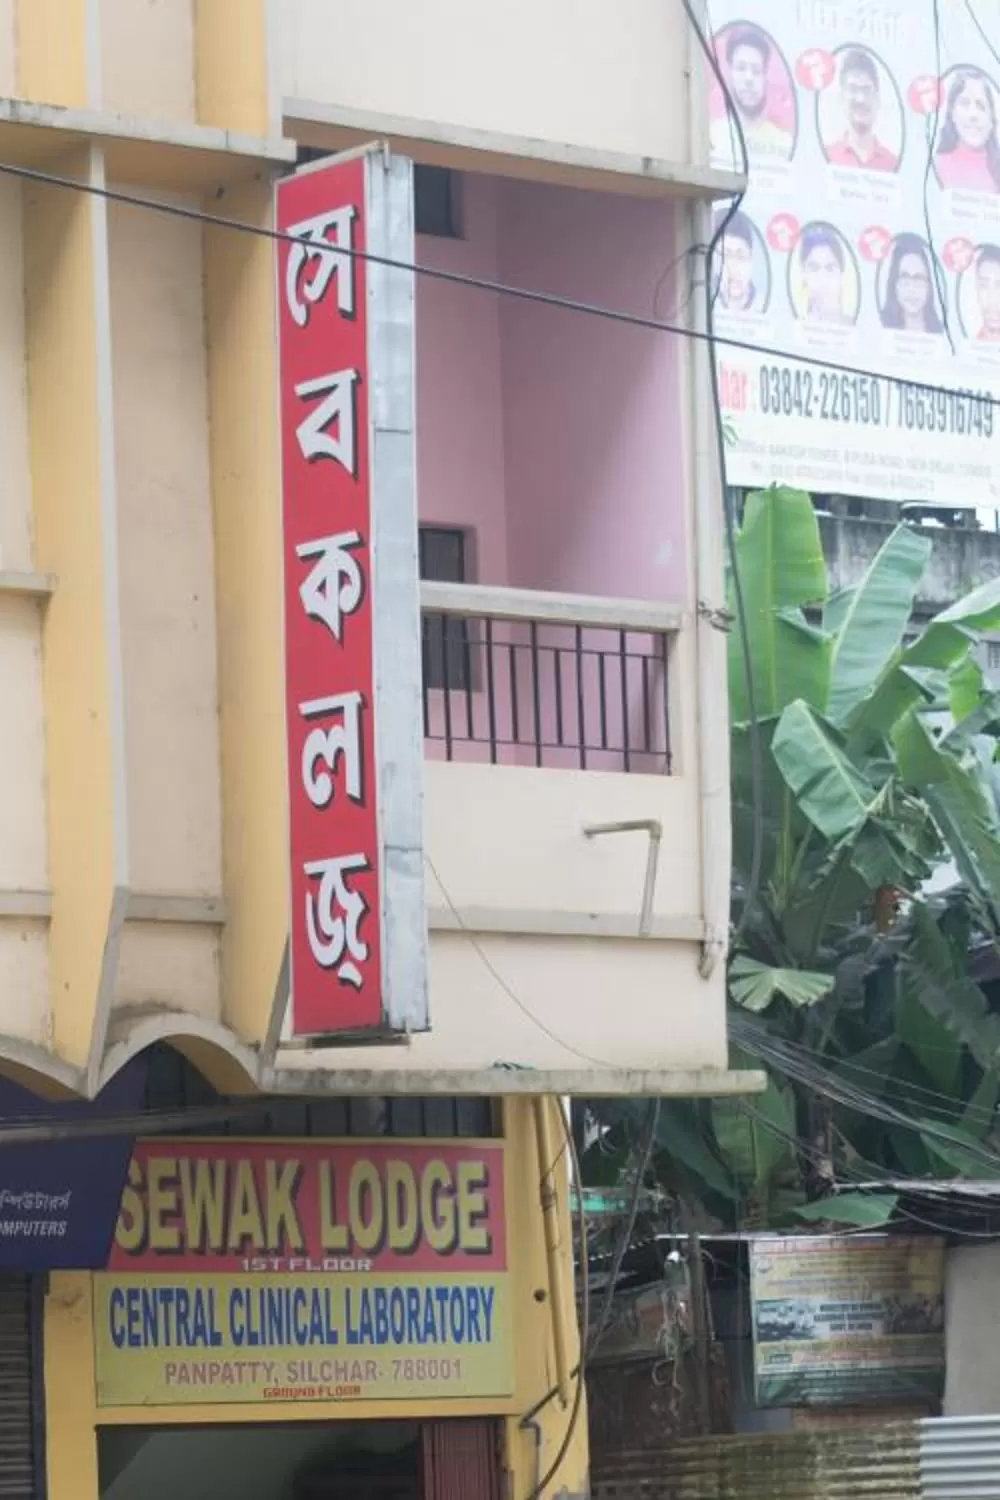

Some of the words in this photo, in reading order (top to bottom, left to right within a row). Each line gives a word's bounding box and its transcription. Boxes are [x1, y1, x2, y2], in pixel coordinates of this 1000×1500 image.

[759, 364, 881, 426] 03842-226150
[114, 1156, 301, 1252] SEWAK
[319, 1157, 491, 1252] LODGE
[242, 1256, 281, 1272] 1ST
[288, 1256, 374, 1272] FLOOR
[109, 1286, 223, 1349] CENTRAL
[229, 1286, 339, 1348] CLINICAL
[346, 1285, 496, 1345] LABORATORY
[164, 1360, 280, 1385] PANPATTY,
[391, 1358, 463, 1382] 788001
